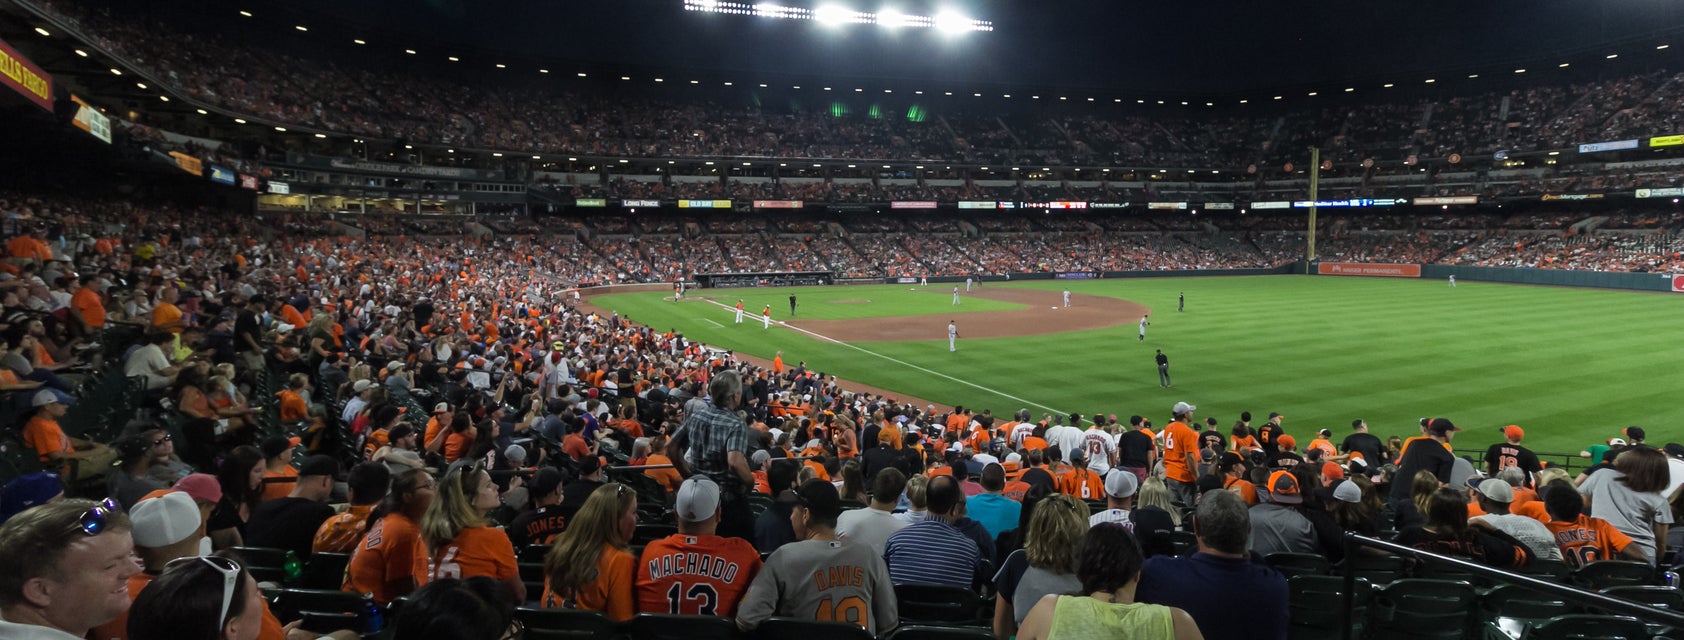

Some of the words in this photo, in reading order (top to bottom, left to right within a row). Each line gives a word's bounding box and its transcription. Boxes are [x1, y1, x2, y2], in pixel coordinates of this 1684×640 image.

[1089, 440, 1101, 455] 13
[1165, 432, 1174, 449] 6
[1081, 480, 1091, 499] 6
[527, 516, 566, 538] JONES
[649, 552, 738, 584] MACHADO
[814, 564, 864, 592] DAVIS
[667, 581, 718, 616] 13
